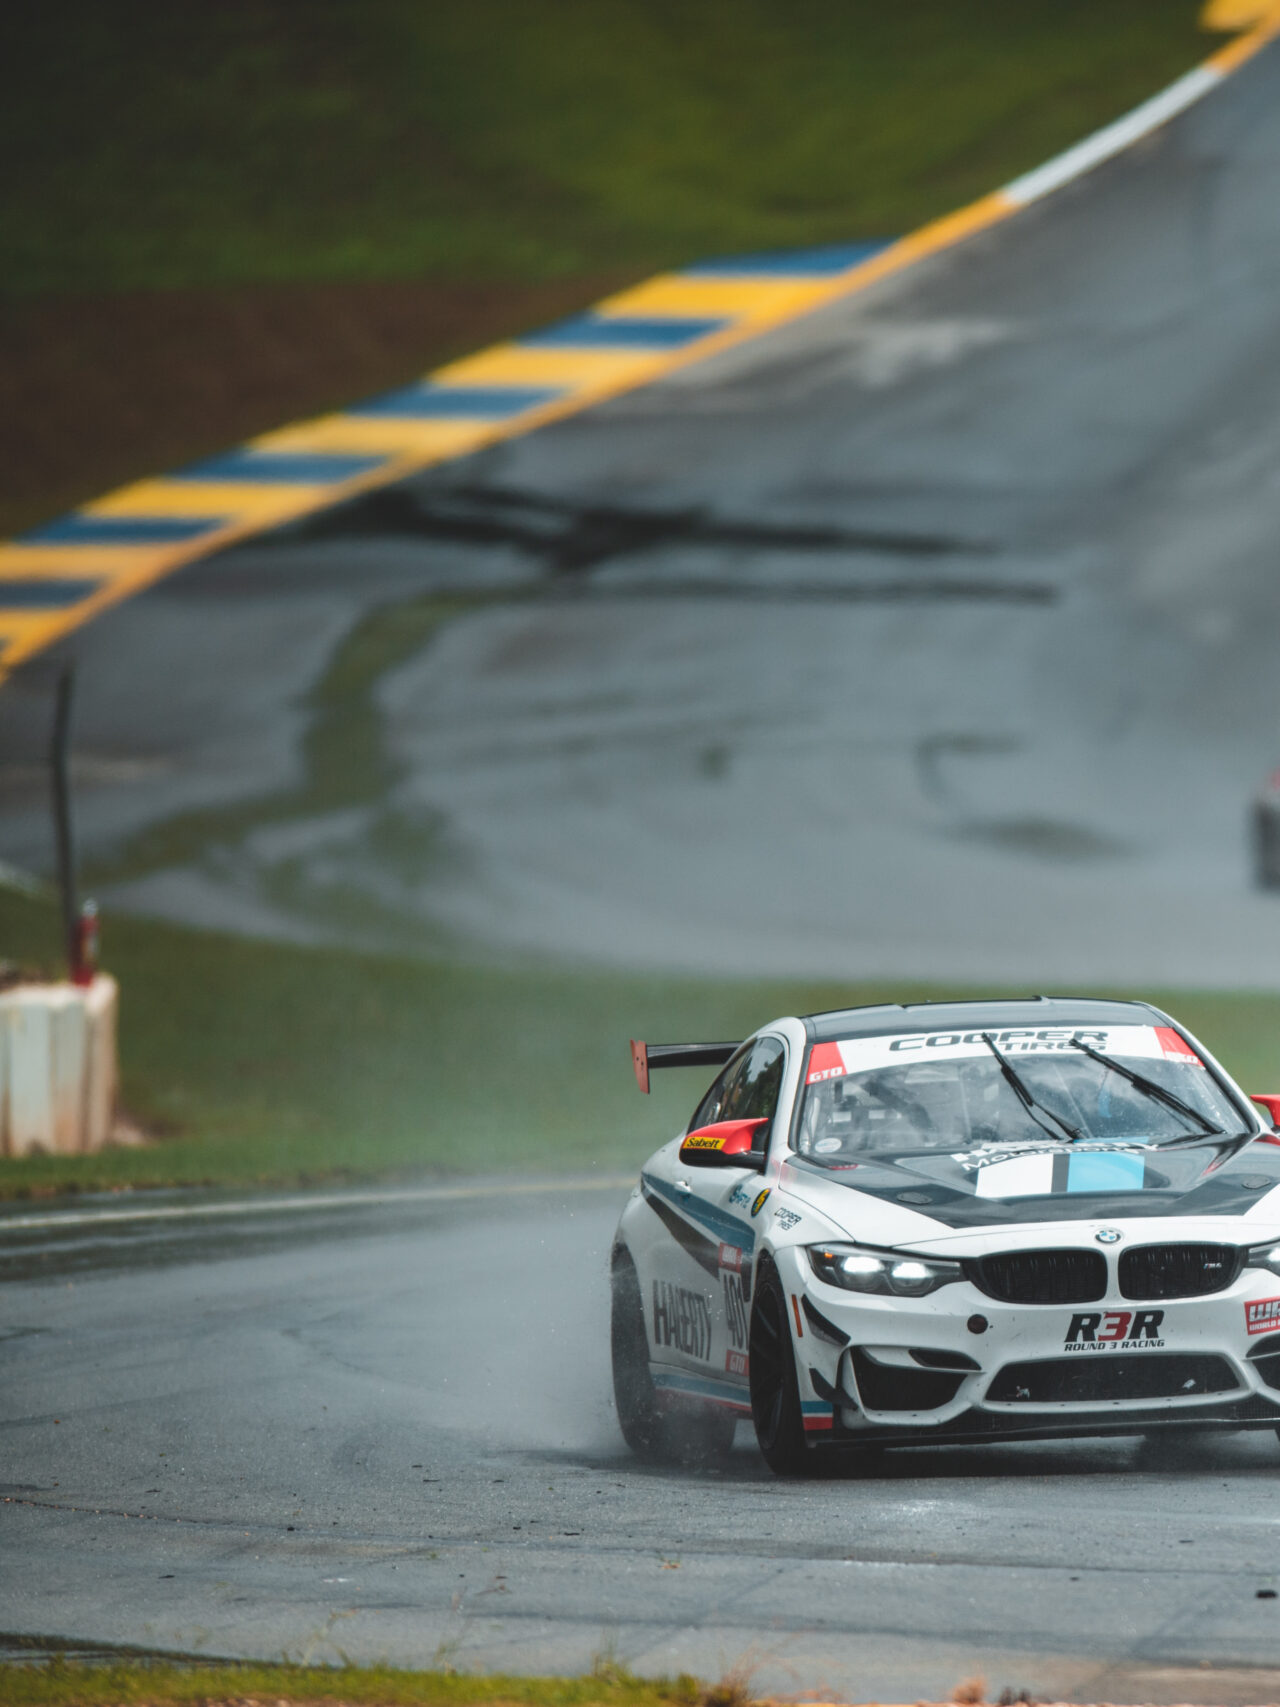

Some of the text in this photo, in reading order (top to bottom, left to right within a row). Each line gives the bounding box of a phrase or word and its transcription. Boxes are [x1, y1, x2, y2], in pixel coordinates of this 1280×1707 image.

[889, 1031, 1109, 1051] COOPER
[999, 1042, 1107, 1051] TIRES
[809, 1066, 843, 1082] GTO
[687, 1137, 720, 1149] Sabelt
[1064, 1309, 1165, 1342] R3R
[1064, 1339, 1165, 1352] ROUND 3 RACING
